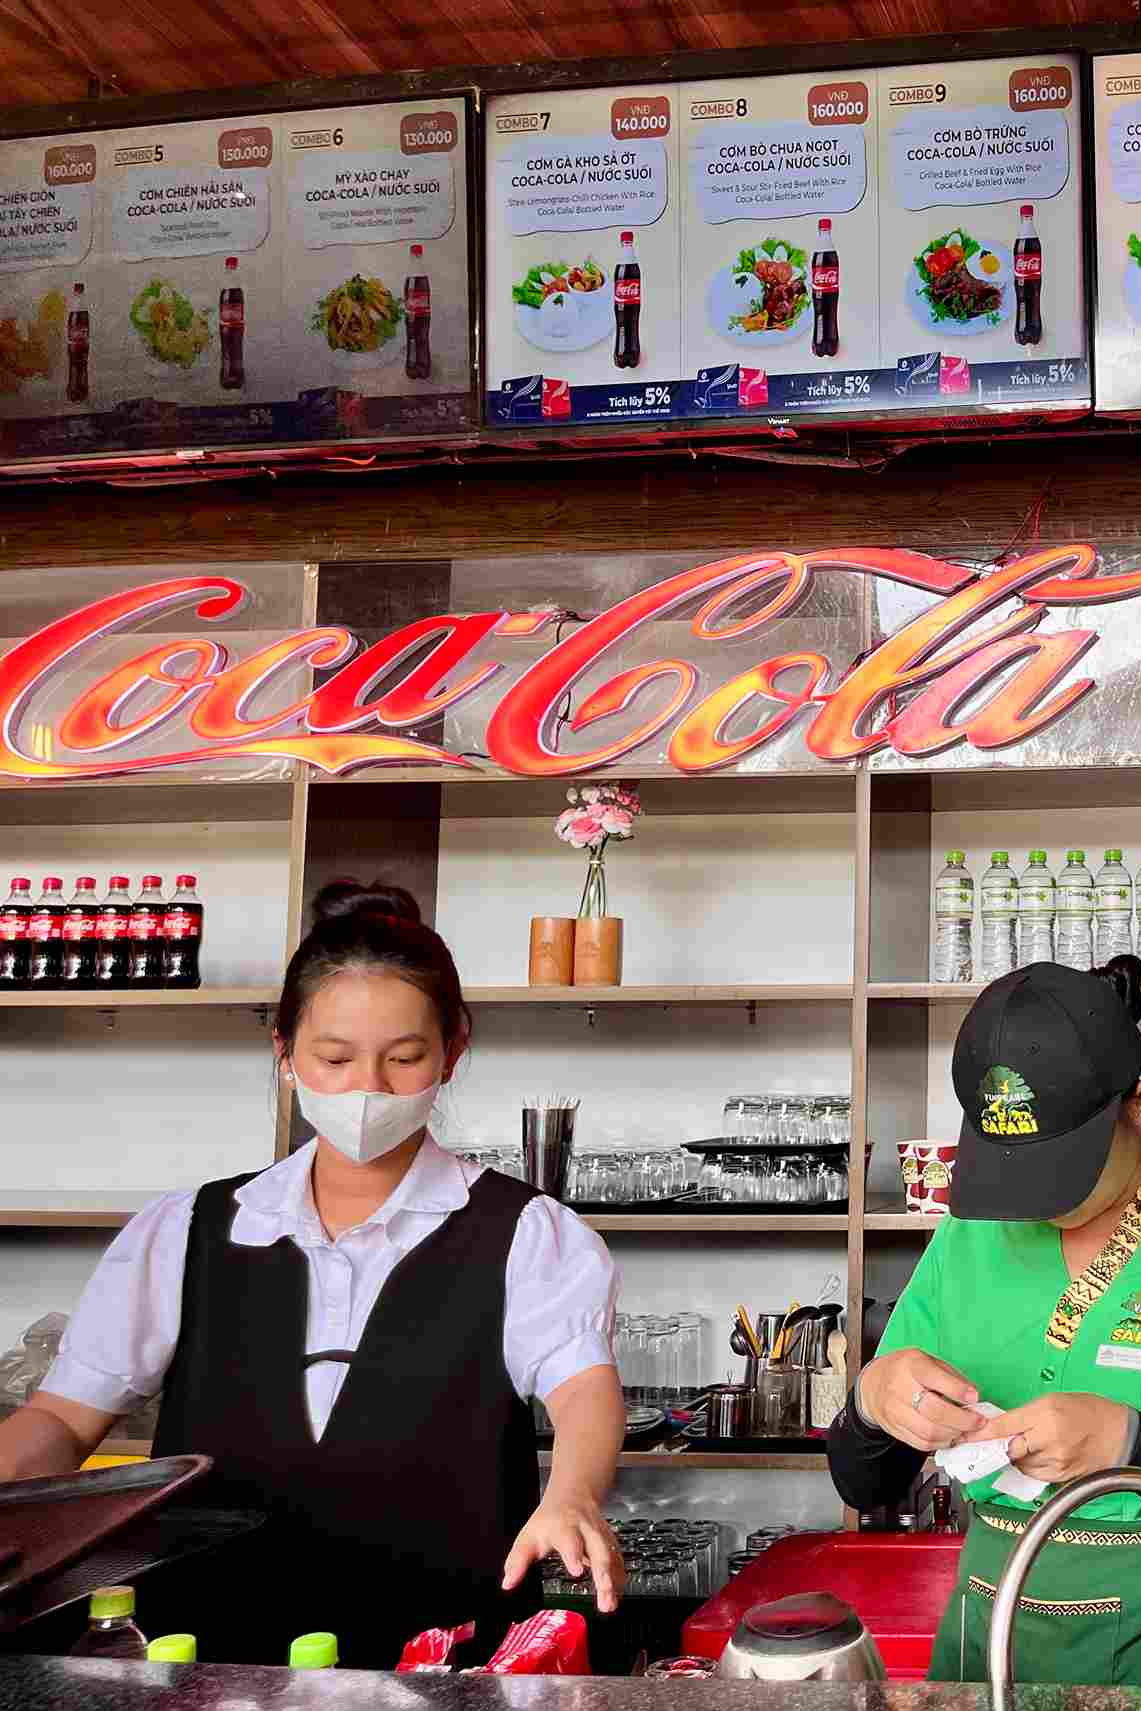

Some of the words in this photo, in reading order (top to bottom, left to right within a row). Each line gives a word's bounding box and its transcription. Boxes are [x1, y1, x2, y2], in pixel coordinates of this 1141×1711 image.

[889, 88, 933, 101] COMBO
[935, 84, 946, 102] 9
[1015, 87, 1066, 103] 160.000
[691, 103, 734, 116] COMBO
[736, 99, 747, 116] 8
[812, 102, 863, 118] 160.000
[496, 117, 538, 129] COMBO
[540, 113, 550, 130] 7
[616, 115, 666, 131] 140.000
[291, 133, 331, 145] COMBO
[333, 128, 343, 145] 6
[404, 131, 452, 146] 130.000
[114, 150, 153, 162] COMBO
[154, 145, 163, 161] 5
[223, 146, 267, 161] 150.000
[769, 143, 802, 155] CHUA
[907, 146, 976, 160] COCA-COLA
[575, 157, 600, 168] KHO
[707, 161, 775, 175] COCA-COLA
[512, 173, 577, 187] COCA-COLA
[306, 187, 369, 202] COCA-COLA
[128, 202, 187, 216] COCA-COLA
[1049, 364, 1075, 383] 5%
[844, 376, 870, 394] 5%
[645, 387, 670, 405] 5%
[982, 1119, 1038, 1135] SAFARI
